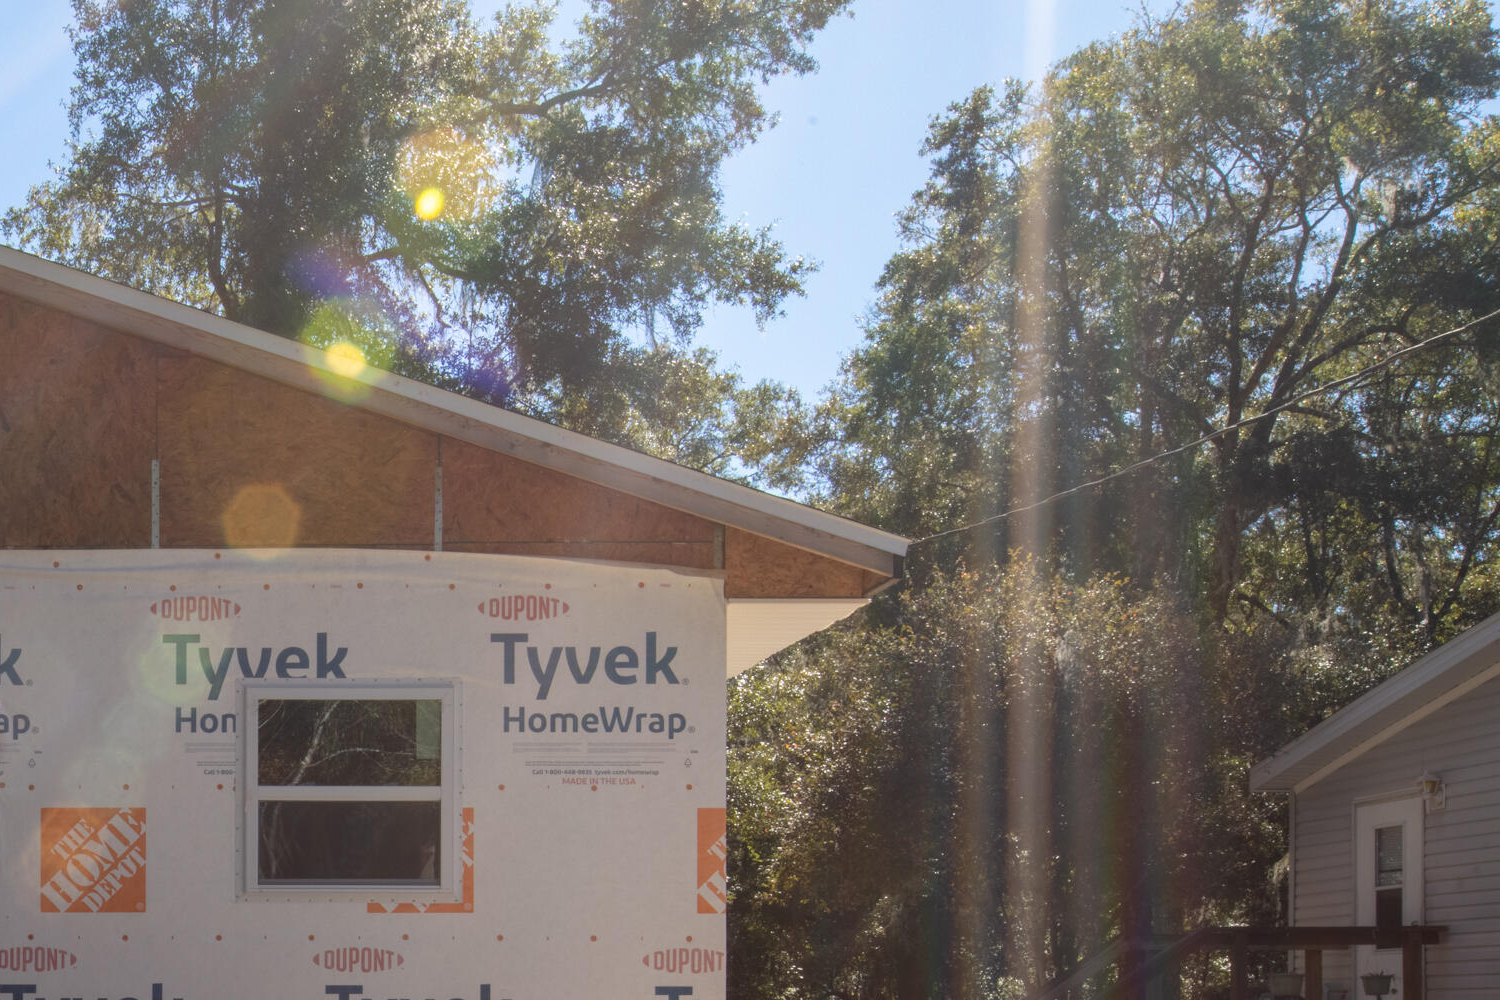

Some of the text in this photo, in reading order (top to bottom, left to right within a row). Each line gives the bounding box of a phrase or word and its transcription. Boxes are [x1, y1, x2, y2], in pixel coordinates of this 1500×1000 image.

[161, 596, 231, 622] DUPONT
[489, 595, 560, 621] DUPONT
[163, 632, 348, 701] Tyvek
[490, 632, 679, 700] Tyvek
[504, 707, 686, 739] HomeWrap
[562, 777, 636, 785] MADE IN THE USA
[51, 817, 95, 860] THE
[41, 808, 146, 912] HOME
[82, 846, 146, 912] DEPOT
[324, 947, 394, 973] DUPONT
[654, 948, 724, 974] DUPONT
